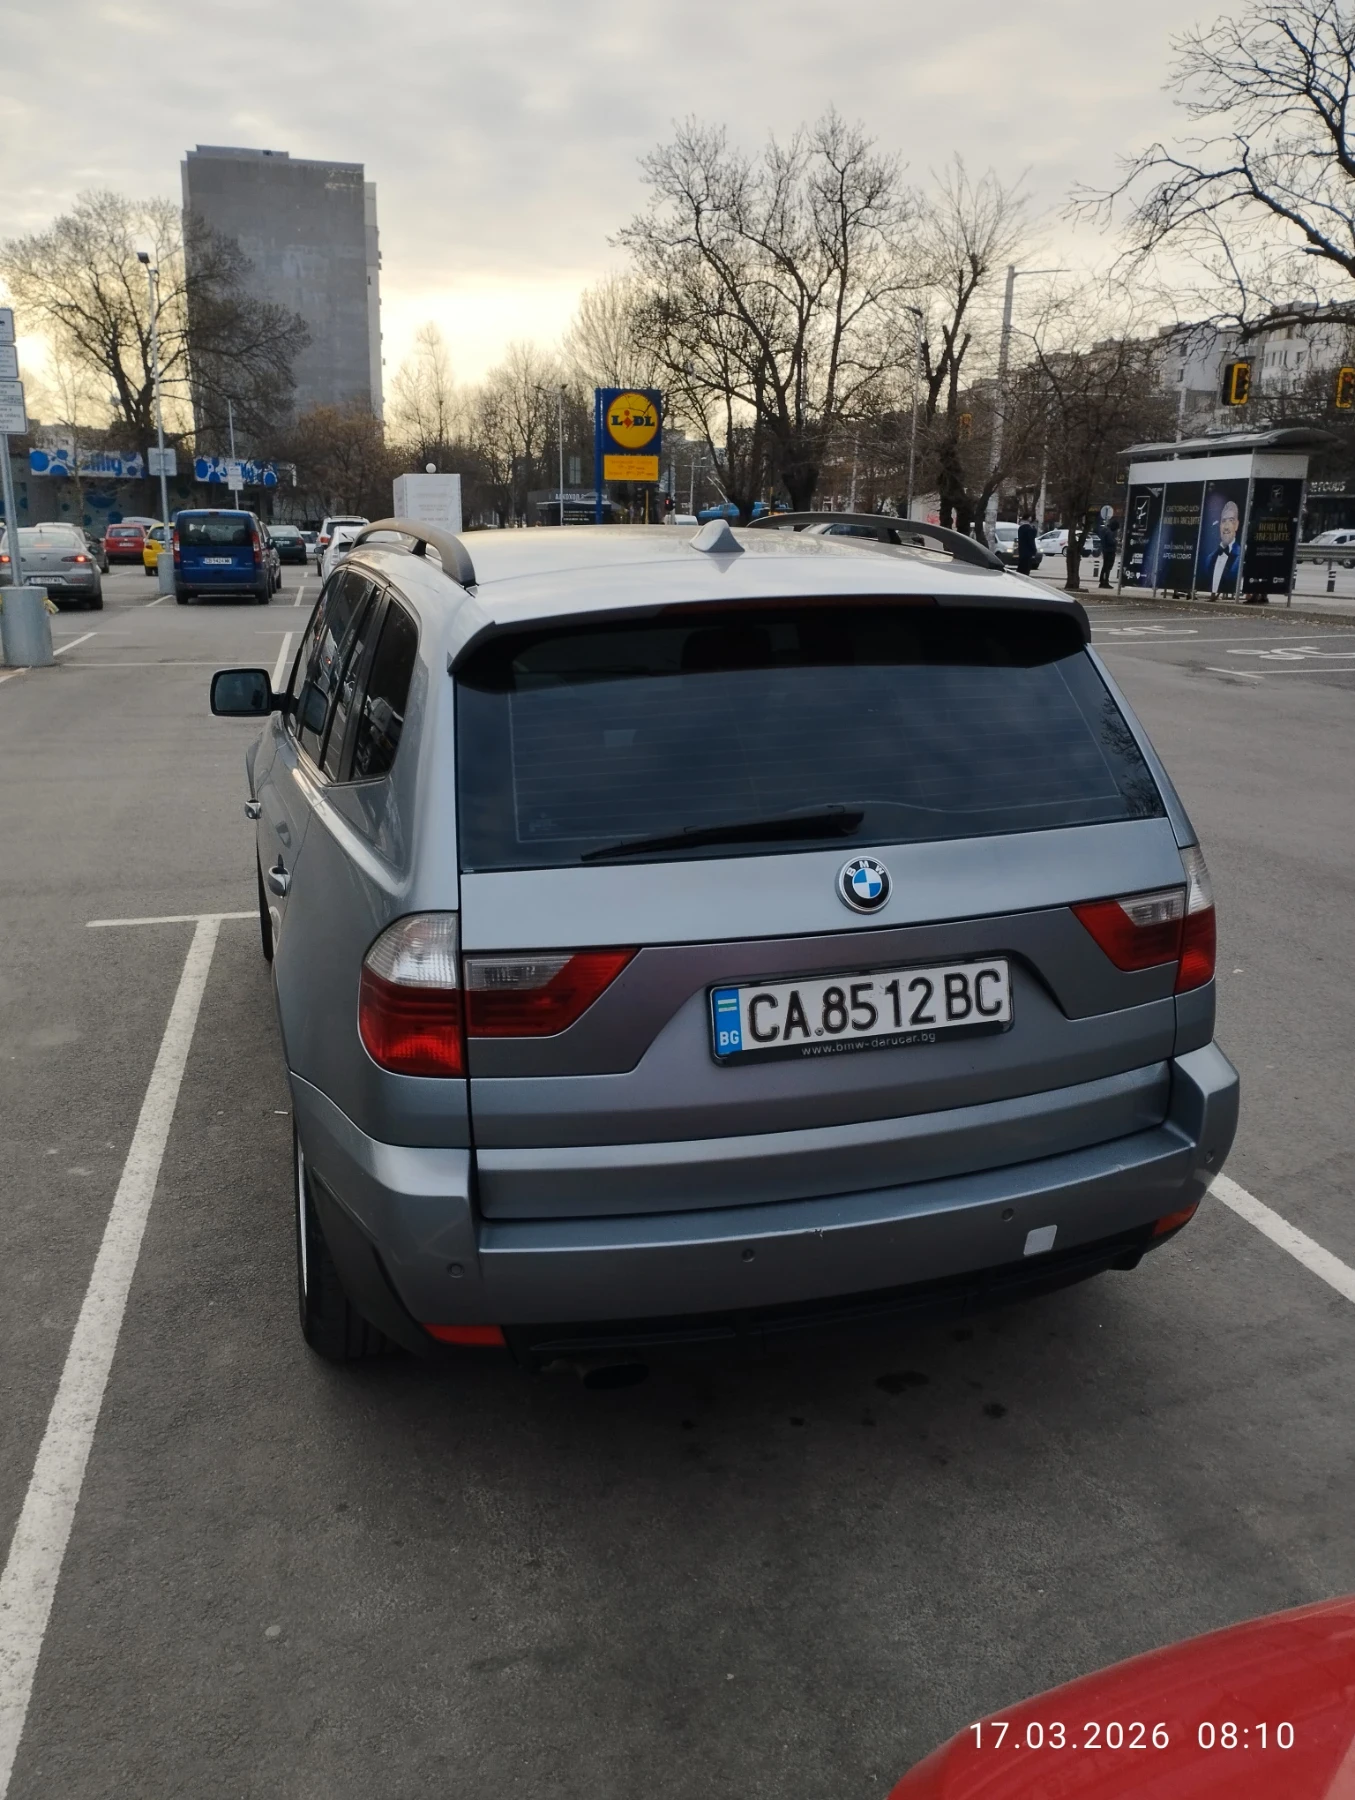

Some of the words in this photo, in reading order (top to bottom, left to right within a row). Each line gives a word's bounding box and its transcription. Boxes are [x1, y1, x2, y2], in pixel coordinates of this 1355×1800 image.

[846, 860, 885, 877] BMW
[719, 1030, 740, 1047] BG
[801, 1032, 936, 1056] www.bmw-darucar.bg
